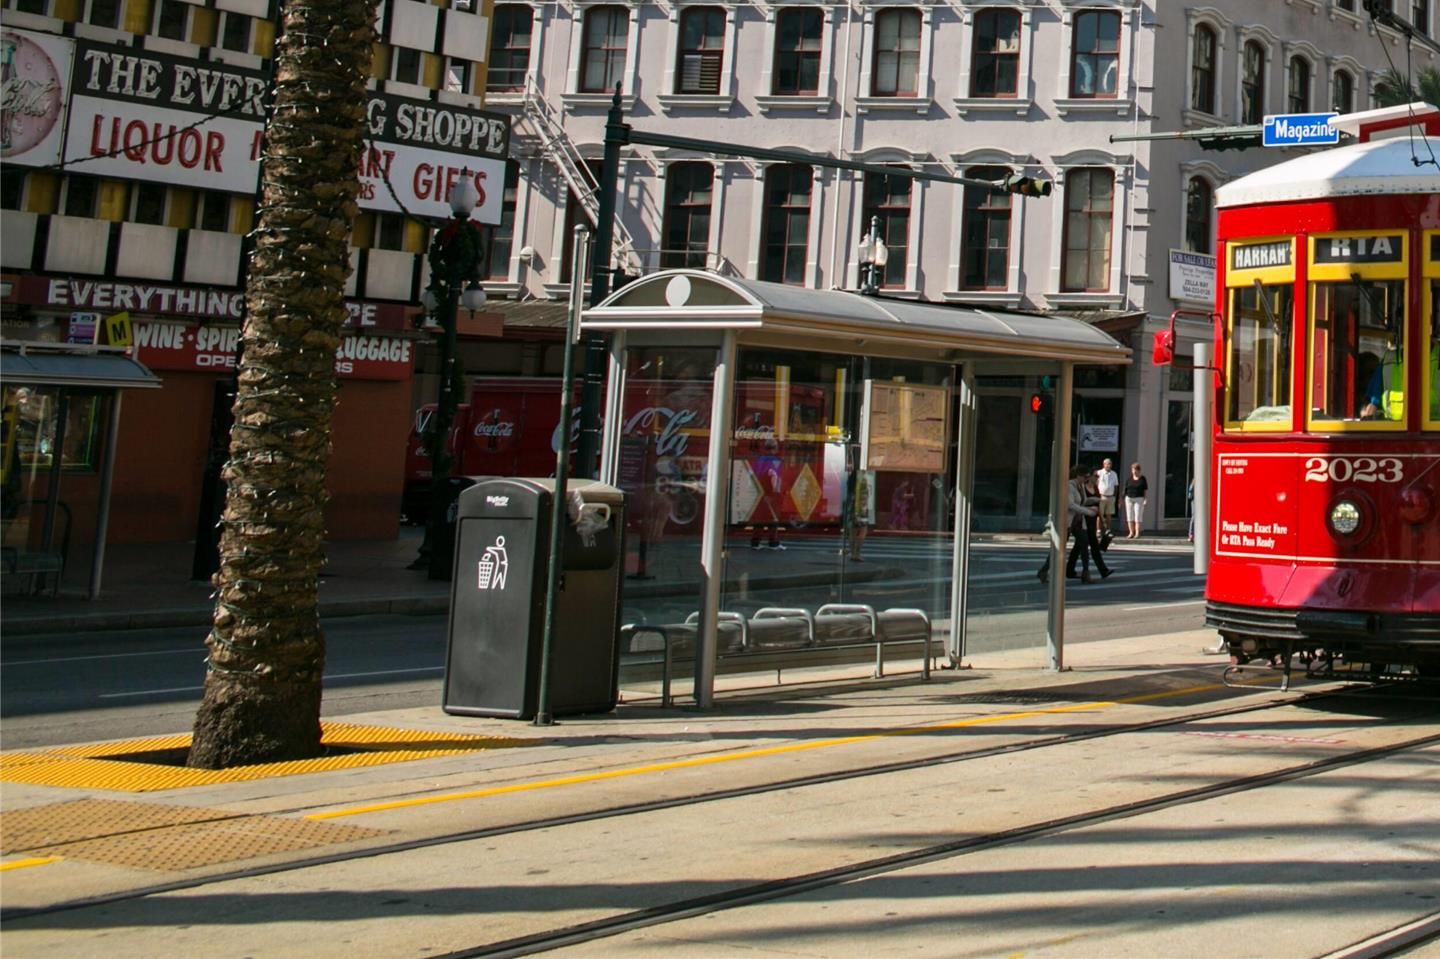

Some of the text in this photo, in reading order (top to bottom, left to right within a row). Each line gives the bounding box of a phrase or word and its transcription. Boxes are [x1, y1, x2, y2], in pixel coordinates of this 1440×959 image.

[84, 50, 163, 98] THE
[395, 107, 507, 152] SHOPPE
[1275, 120, 1336, 142] Magazine
[90, 114, 226, 174] LIQUOR
[413, 162, 487, 208] GIFS
[1235, 242, 1292, 268] HARRAH'
[1330, 237, 1393, 257] RTA
[112, 321, 127, 343] M
[133, 323, 185, 350] WINE
[195, 326, 238, 353] SPIR
[196, 354, 237, 368] OPE
[474, 422, 513, 437] Coca-Cola
[1305, 457, 1404, 482] 2023
[1238, 521, 1253, 533] Have
[1254, 522, 1271, 534] Exact
[1273, 523, 1288, 535] Fare
[1229, 534, 1241, 545] RTA
[1242, 535, 1255, 547] Pass
[1256, 536, 1275, 550] Ready
